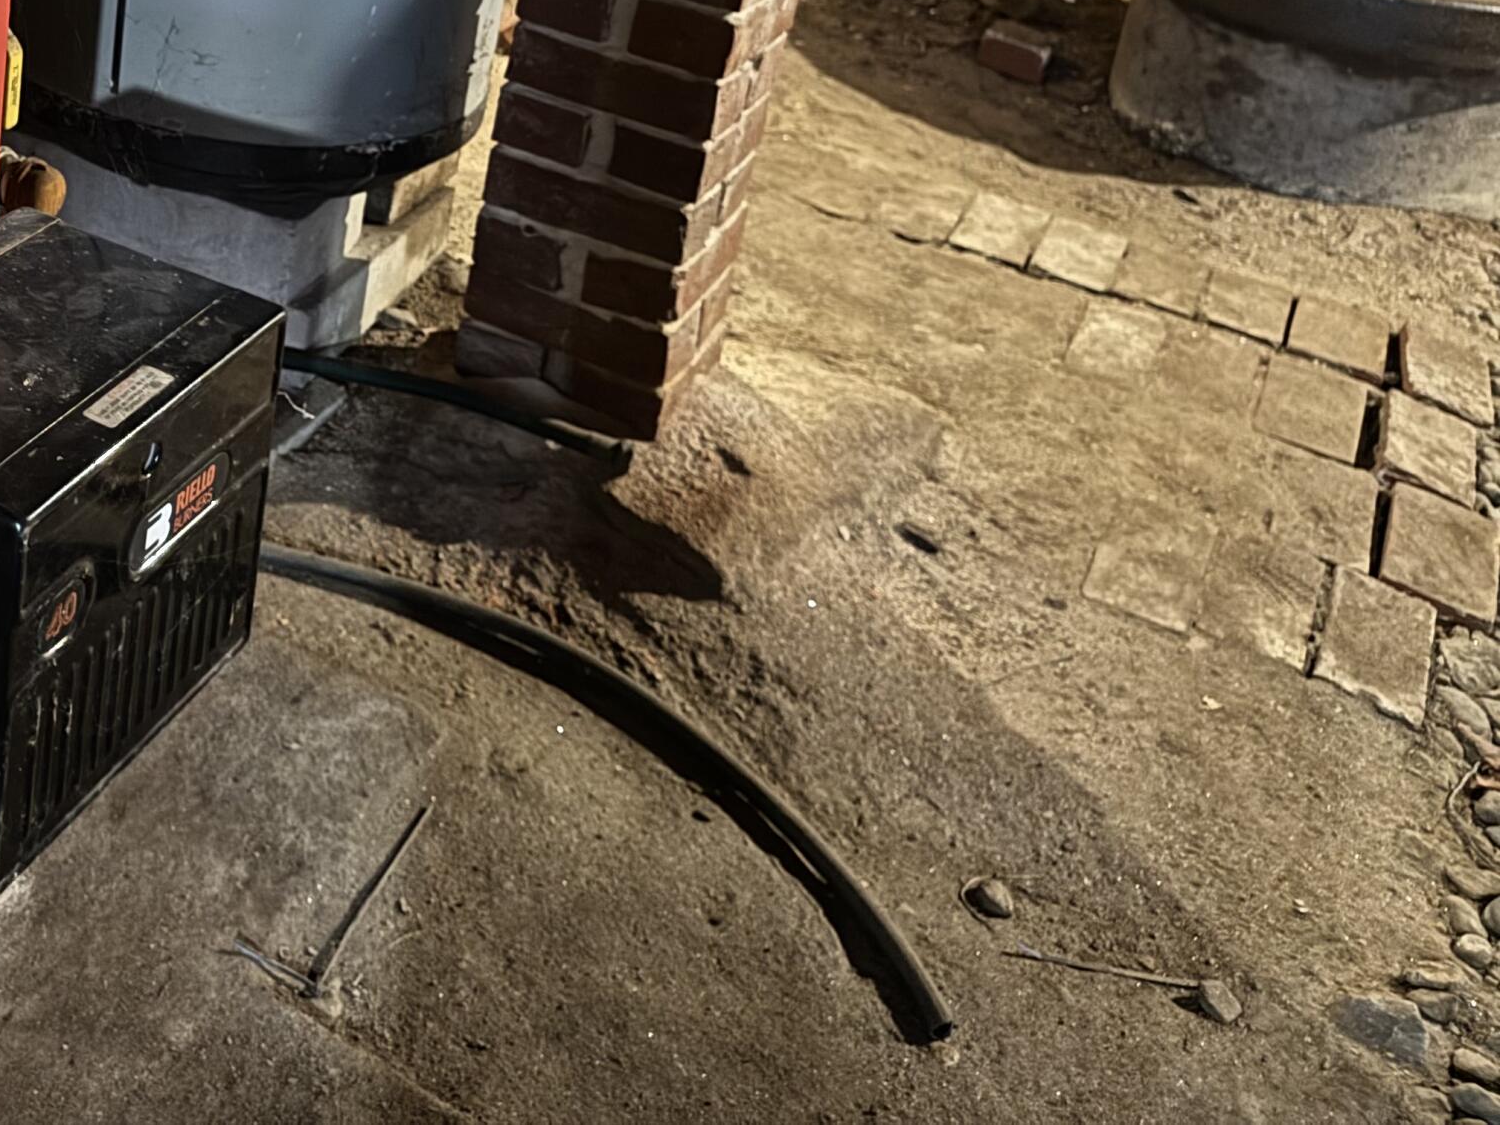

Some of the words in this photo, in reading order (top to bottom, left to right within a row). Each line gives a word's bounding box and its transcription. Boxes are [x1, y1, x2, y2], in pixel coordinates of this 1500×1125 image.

[173, 492, 213, 533] BURNERS
[175, 464, 216, 515] RIELLO
[45, 592, 77, 641] 40
